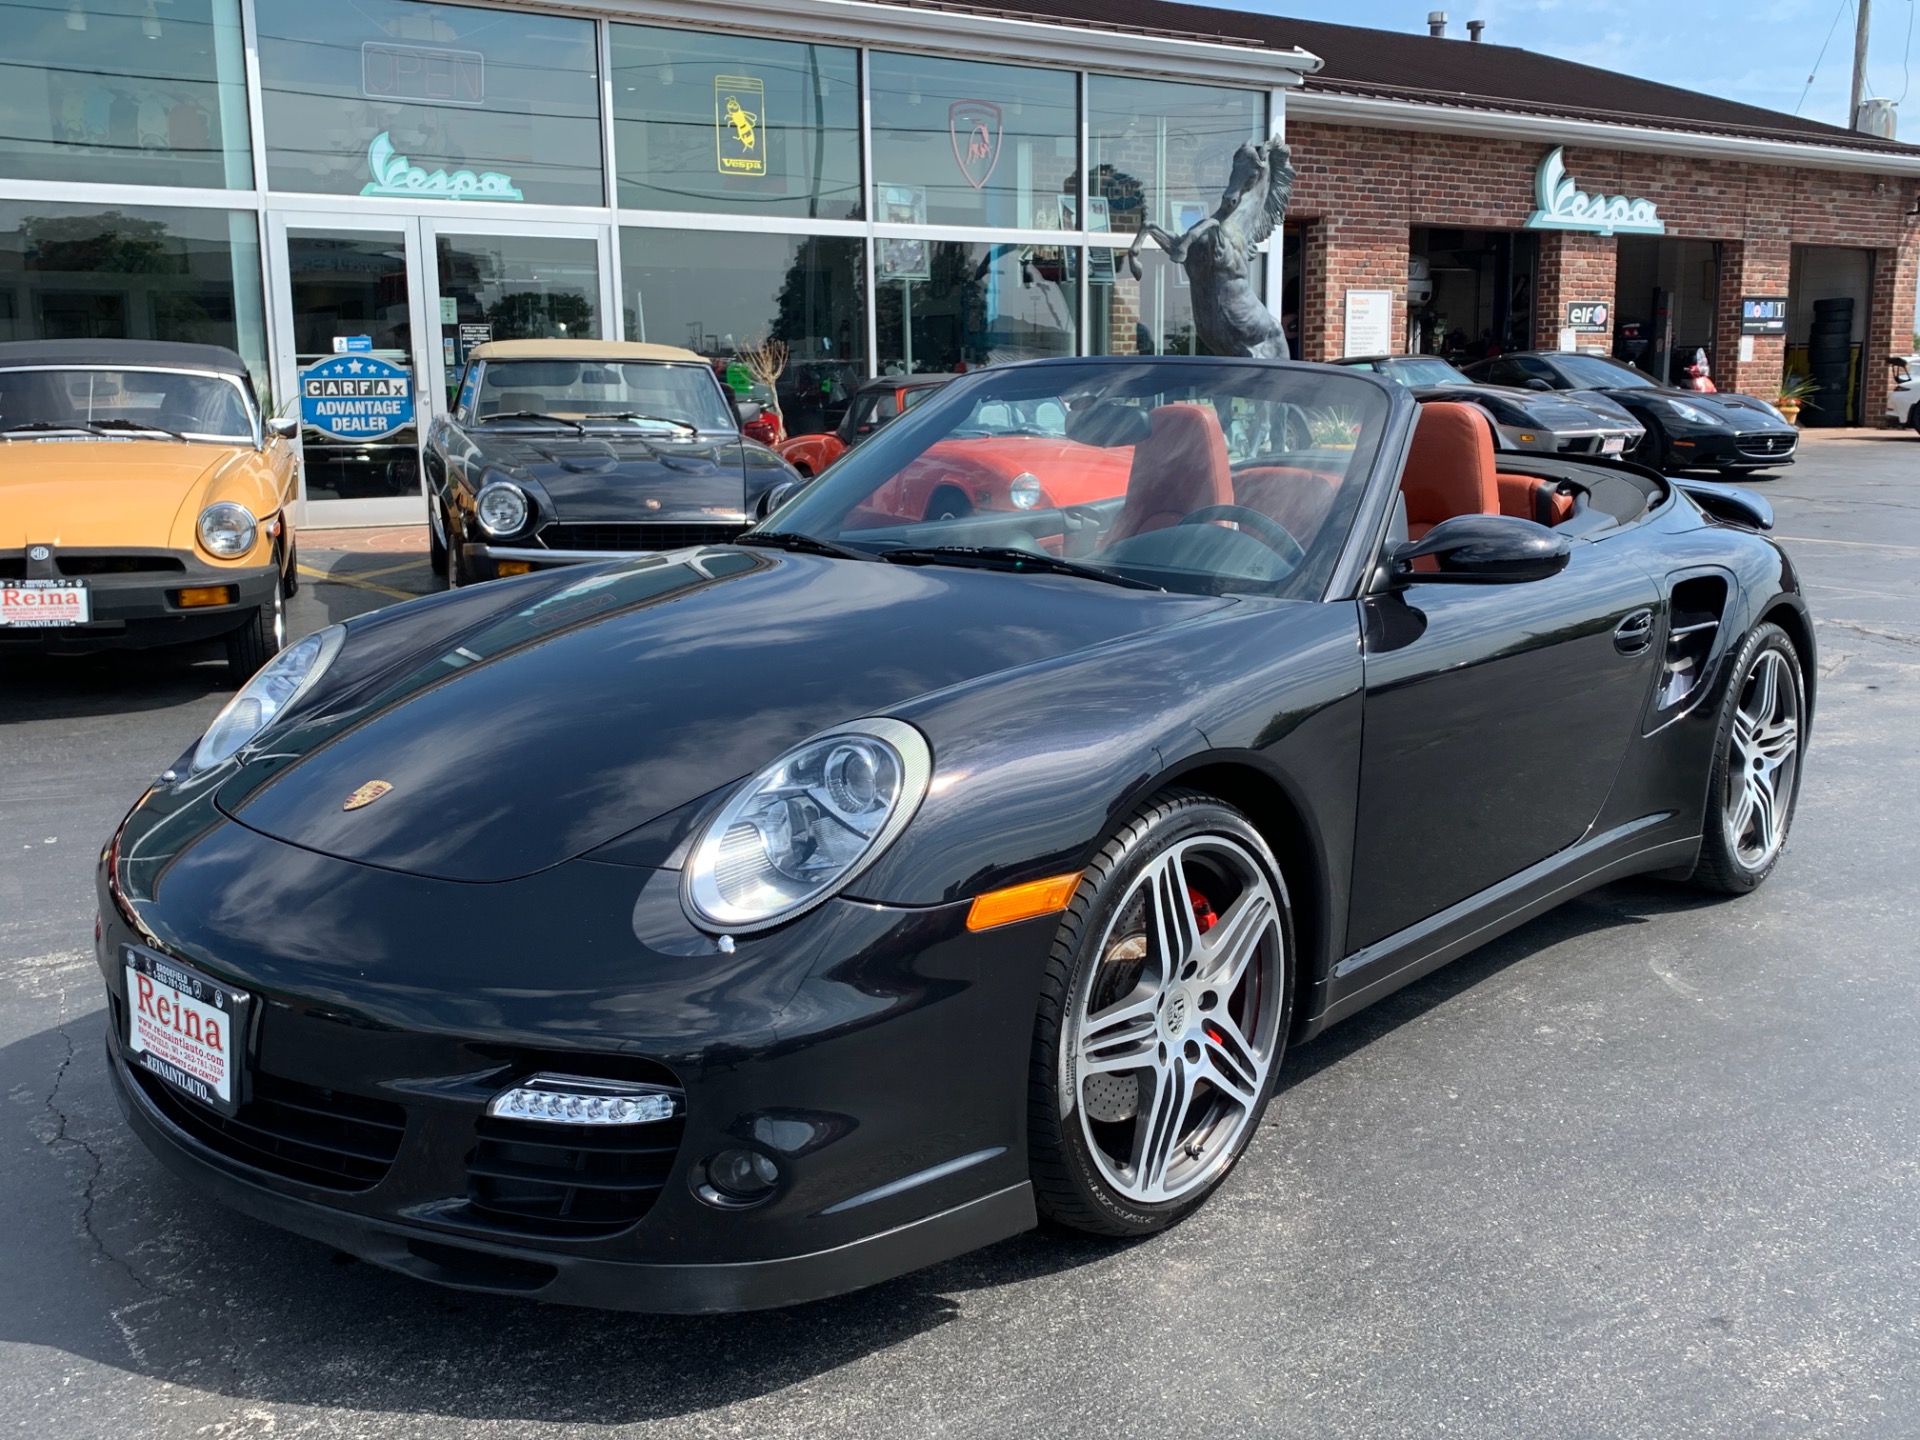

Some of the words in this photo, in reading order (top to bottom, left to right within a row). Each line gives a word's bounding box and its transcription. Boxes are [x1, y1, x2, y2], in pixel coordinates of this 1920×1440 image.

[366, 47, 479, 100] OPEN
[362, 131, 521, 200] Vespa
[721, 158, 762, 170] Vespa
[1527, 145, 1664, 236] Vespa
[1570, 307, 1594, 323] elf
[1744, 301, 1774, 318] Mobil
[307, 381, 405, 397] CARFAX
[316, 400, 402, 415] ADVANTAGE
[331, 416, 388, 431] DEALER
[2, 588, 79, 606] Reina
[156, 962, 188, 985] BROOKFIELD
[135, 972, 224, 1051] Reina
[137, 1015, 224, 1067] www.reinaintlauto.com
